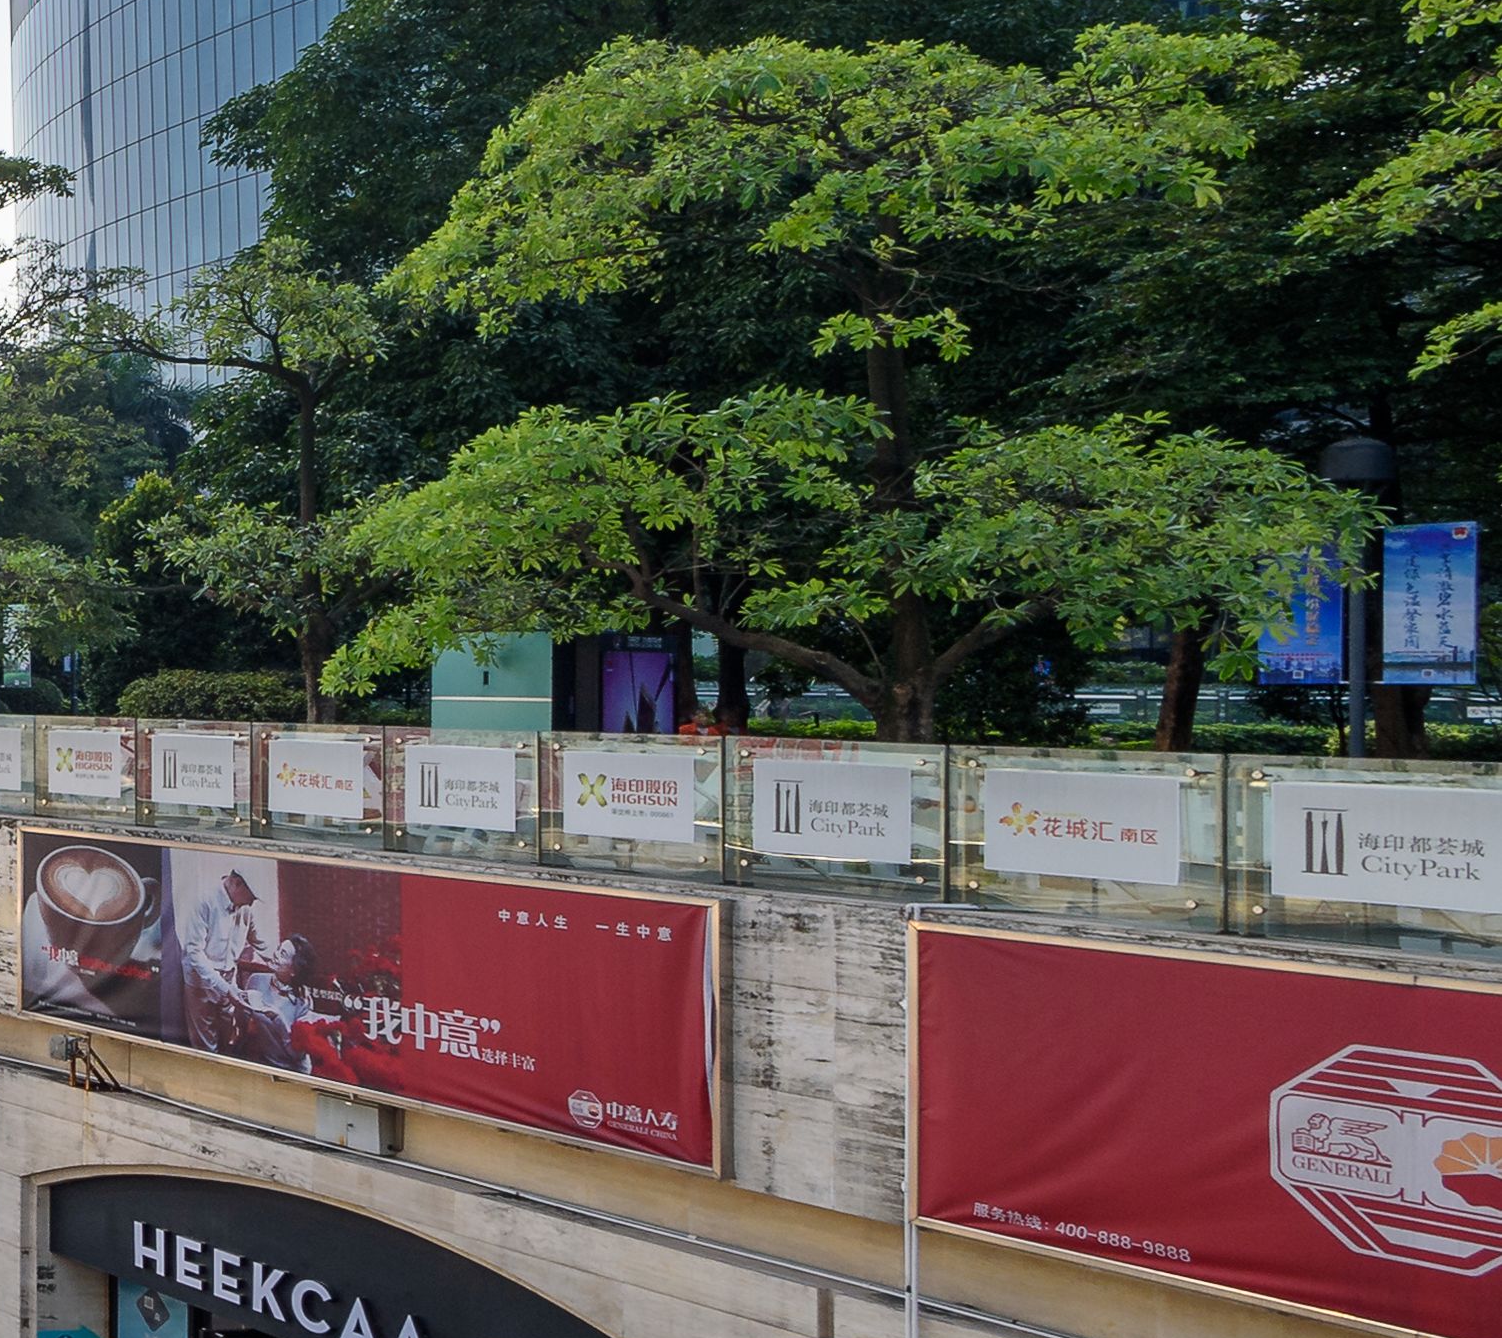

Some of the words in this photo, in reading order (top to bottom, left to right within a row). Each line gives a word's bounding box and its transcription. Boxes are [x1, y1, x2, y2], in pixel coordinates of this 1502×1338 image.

[74, 761, 113, 771] HIGHSUN
[180, 762, 223, 777] 海印都荟城
[181, 776, 222, 791] CityPark
[297, 773, 333, 790] 花城汇
[334, 778, 354, 791] 南区
[443, 777, 500, 794] 海印都荟城
[610, 777, 679, 795] 海印股份
[445, 792, 499, 811] CityPark
[611, 792, 679, 808] HIGHSUN
[809, 797, 890, 820] 海印都荟城
[810, 818, 887, 839] CityPark
[1042, 817, 1114, 843] 花城汇
[1120, 828, 1159, 846] 南区
[1357, 832, 1486, 857] 海印都荟城
[1360, 855, 1482, 883] CityPark
[498, 908, 569, 931] 中意人生
[595, 920, 674, 944] 一生中意
[482, 1047, 536, 1073] 选择丰富
[606, 1102, 679, 1131] 中意人寿
[650, 1129, 678, 1142] CHINA
[1291, 1153, 1393, 1185] GENERALI
[1055, 1220, 1191, 1262] 400-888-9888
